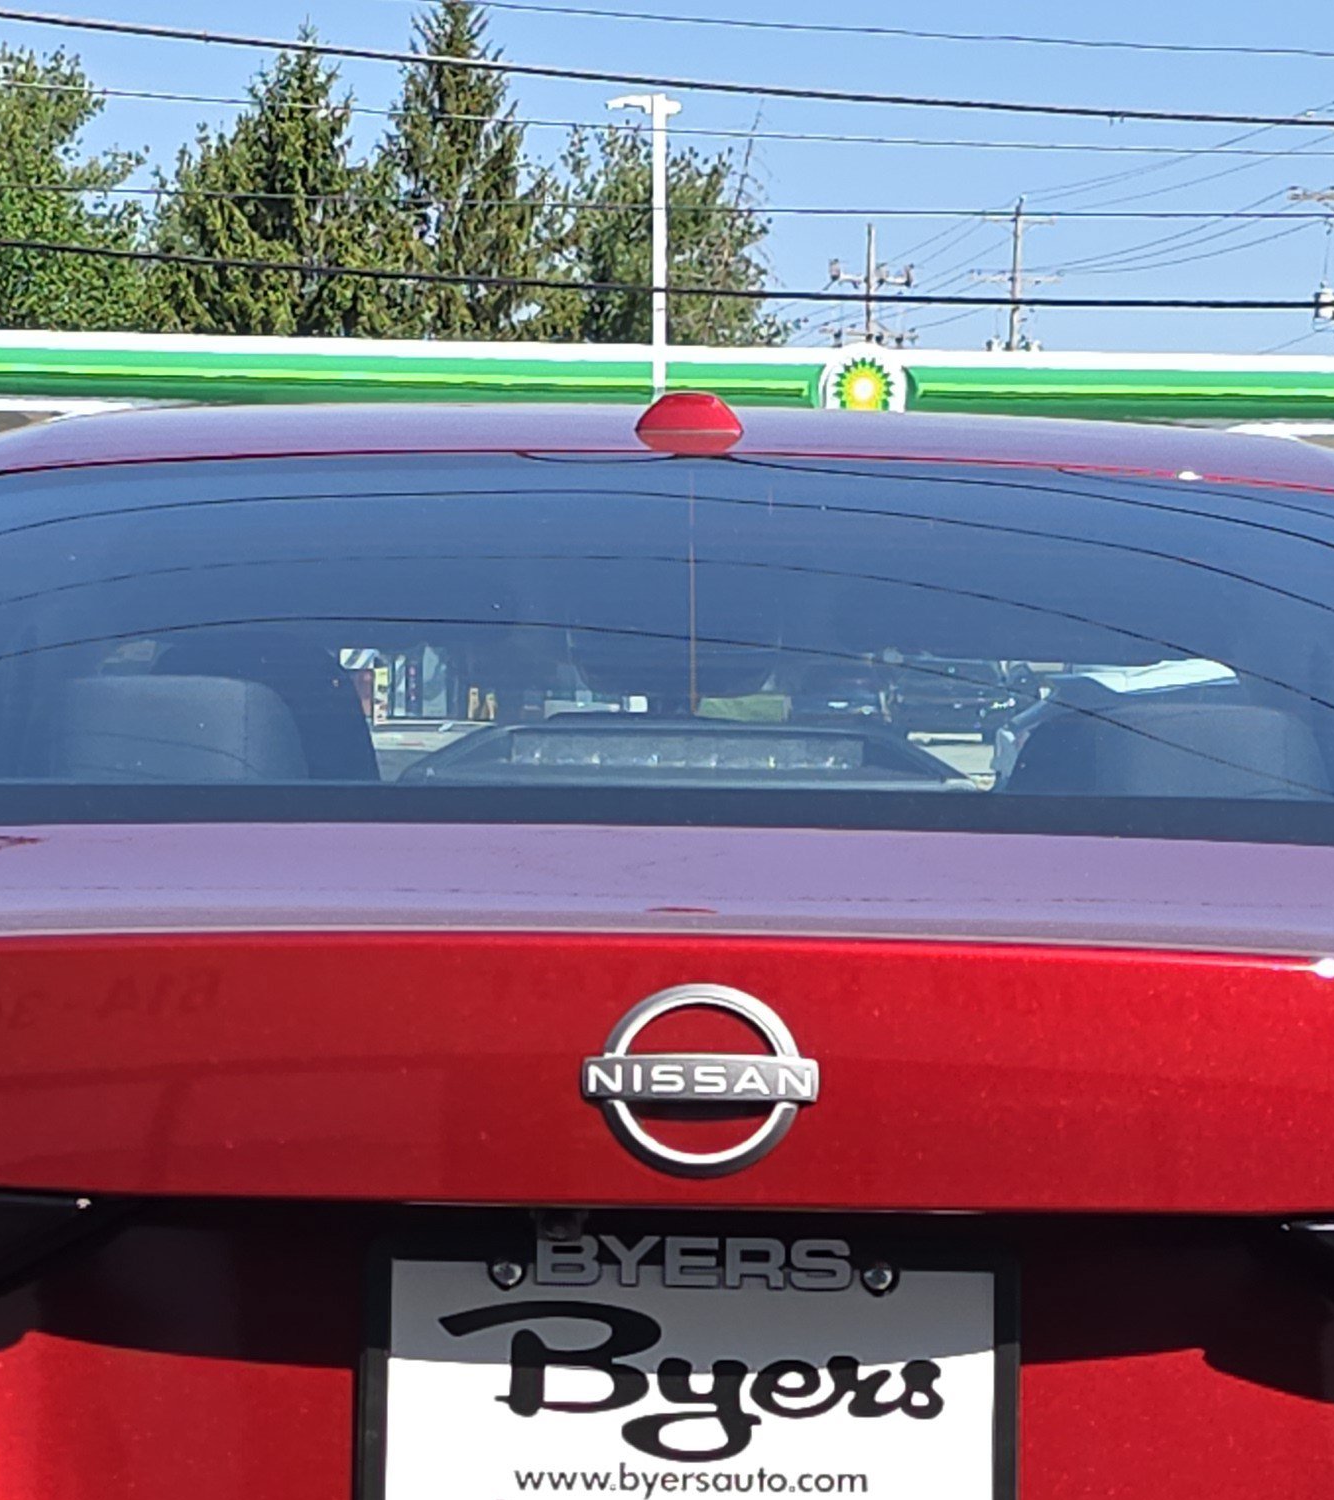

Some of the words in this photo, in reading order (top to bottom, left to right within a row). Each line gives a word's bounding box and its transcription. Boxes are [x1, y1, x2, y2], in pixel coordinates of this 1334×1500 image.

[587, 1063, 813, 1098] NISSAN
[535, 1234, 852, 1291] BYERS
[438, 1299, 945, 1463] Byers
[513, 1461, 869, 1500] www.byersauto.com
